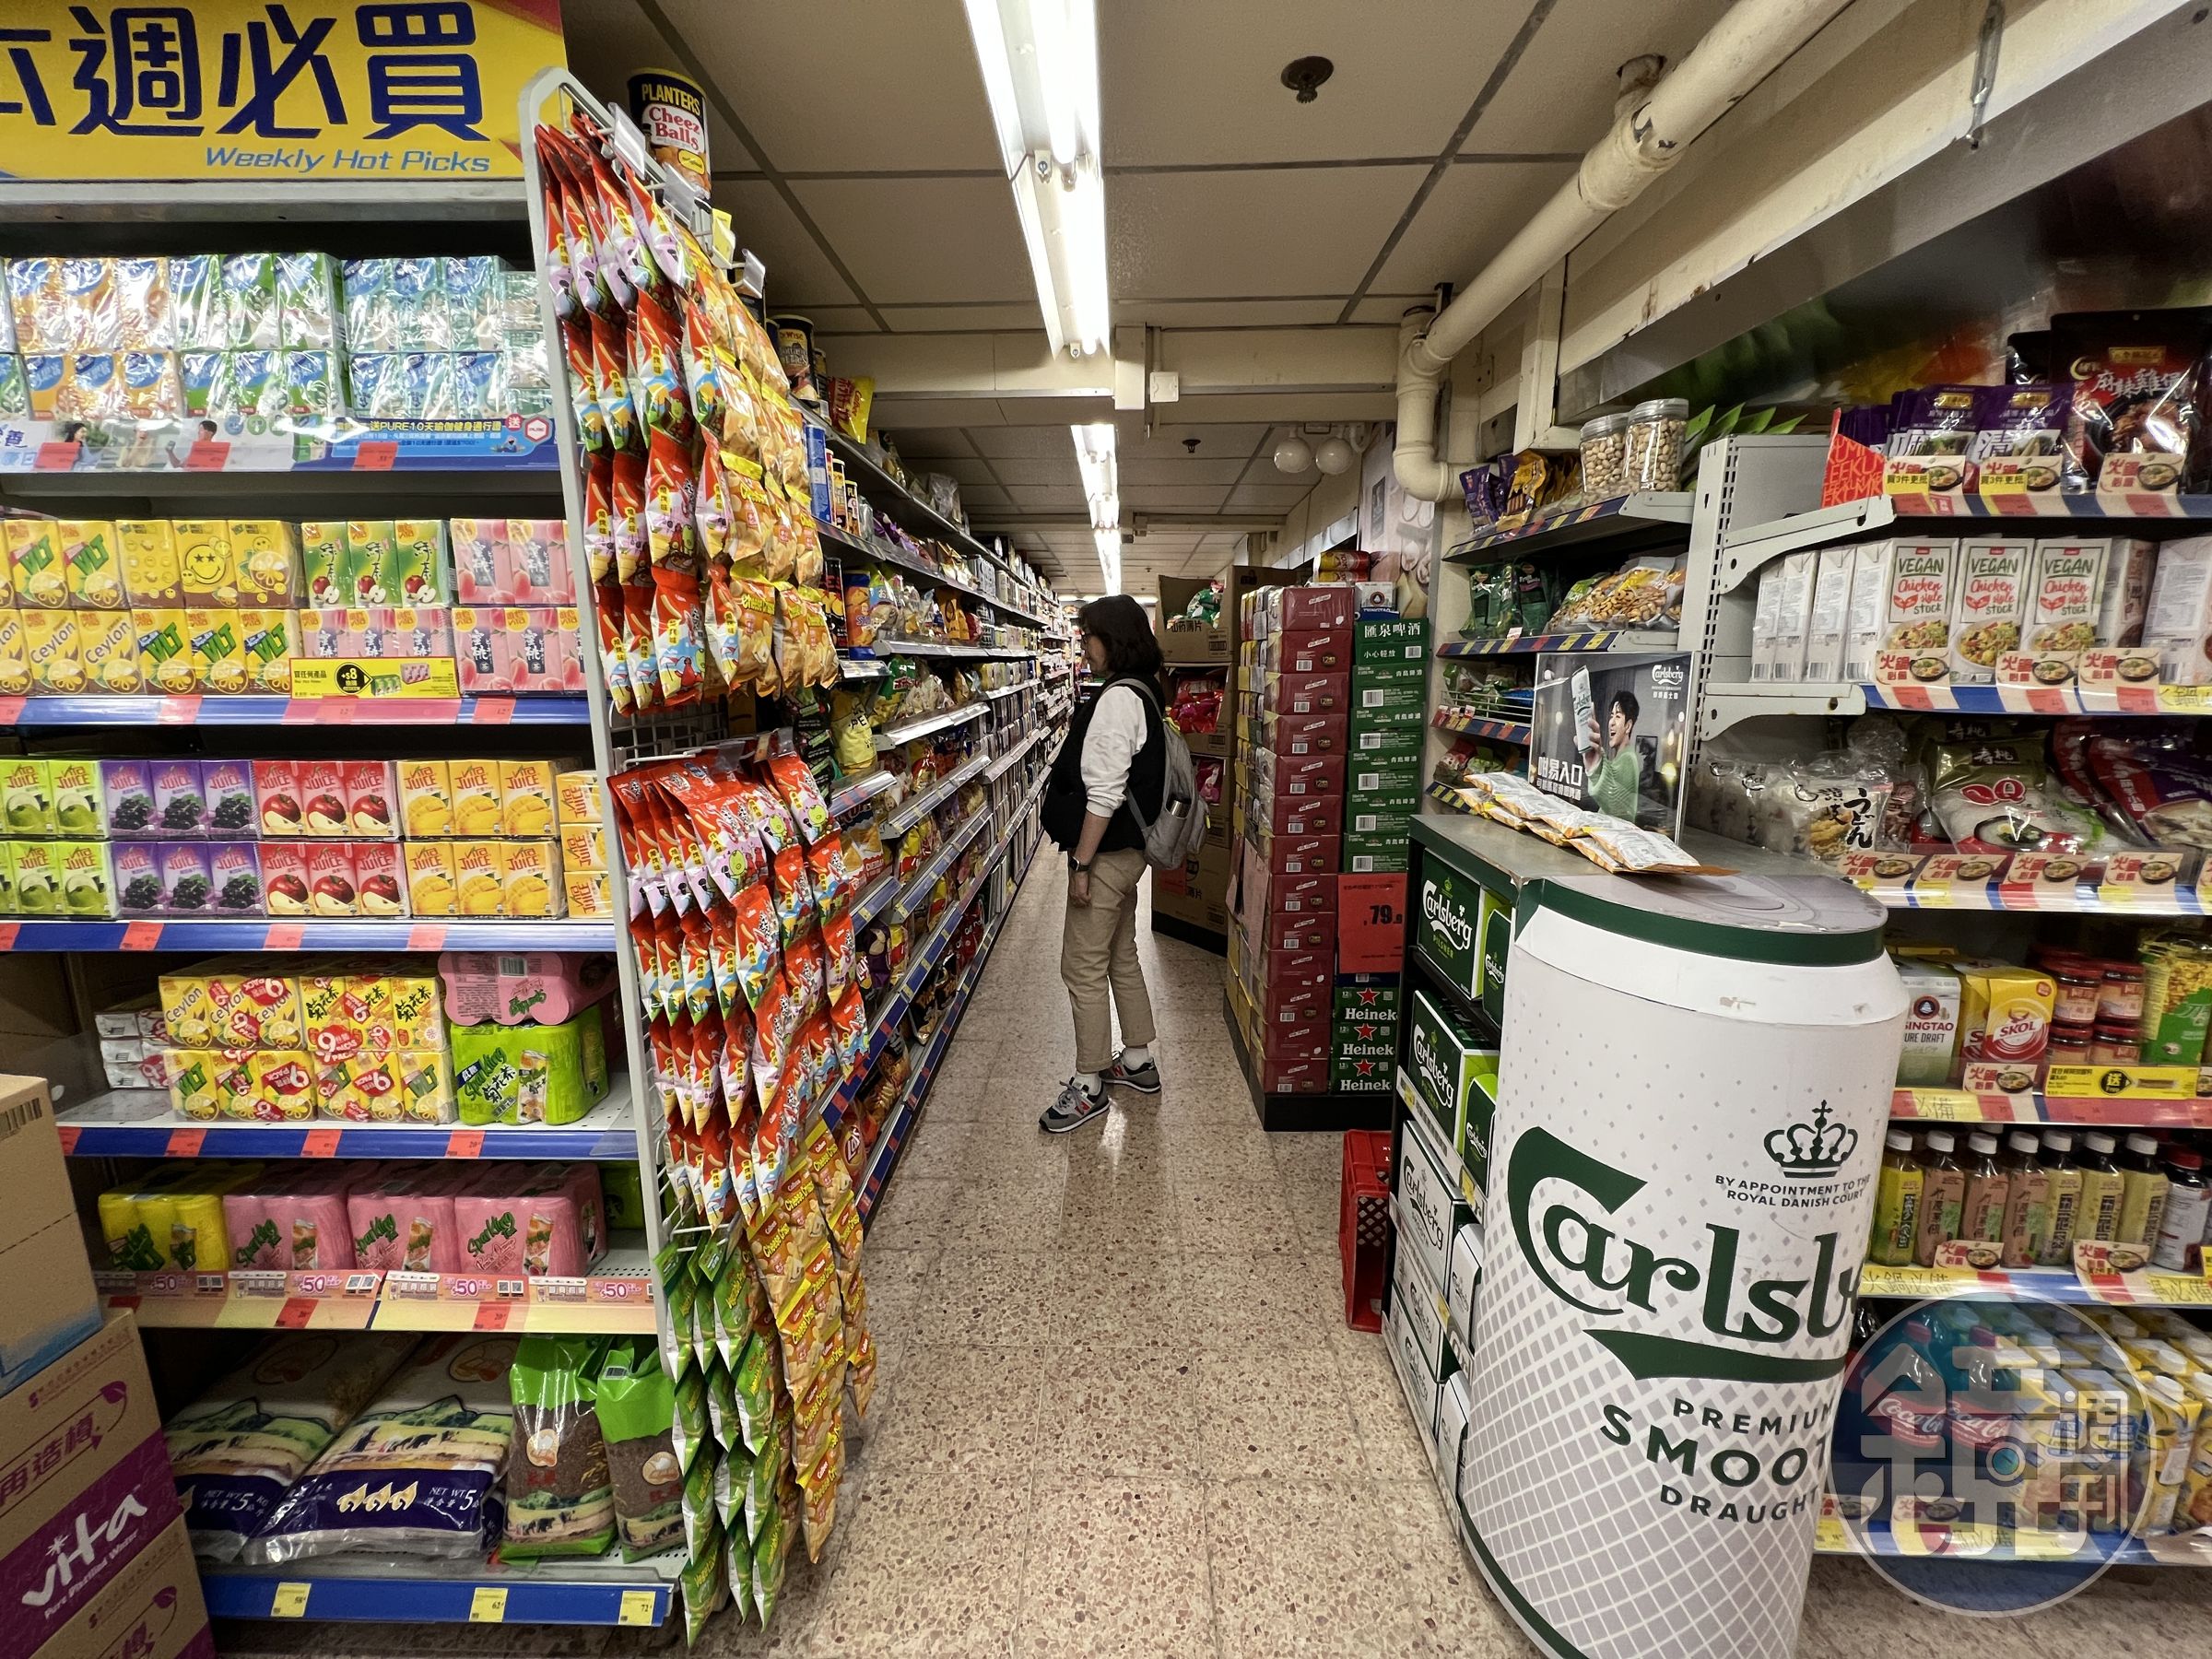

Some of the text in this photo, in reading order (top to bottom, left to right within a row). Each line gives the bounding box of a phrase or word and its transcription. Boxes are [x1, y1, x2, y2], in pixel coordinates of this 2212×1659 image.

[641, 83, 700, 117] PLANTERS
[649, 107, 700, 135] Cheez
[655, 122, 699, 151] Balls
[206, 147, 489, 173] Weekly Hot Picks
[1899, 558, 1944, 573] VEGAN
[1971, 558, 2018, 573] VEGAN
[2045, 559, 2094, 574] VEGAN
[1898, 578, 1943, 593] Chicken
[1971, 579, 2015, 594] Chicken
[2044, 580, 2090, 594] Chicken
[1364, 622, 1420, 638] 匯泉啤酒
[30, 621, 76, 665] Ceylon
[85, 621, 131, 665] Ceylon
[146, 621, 183, 663] VLT
[200, 621, 237, 663] VLT
[253, 621, 288, 663] VLT
[1652, 665, 1684, 685] Carlsberg
[5, 774, 38, 787] JUICE
[55, 774, 88, 788] JUICE
[404, 774, 436, 789] JUICE
[455, 774, 488, 789] JUICE
[506, 774, 538, 789] JUICE
[1843, 787, 1875, 849] うどん
[19, 856, 50, 868] JUICE
[65, 856, 95, 869] JUICE
[410, 855, 441, 869] JUICE
[460, 855, 491, 869] JUICE
[506, 855, 539, 869] JUICE
[1423, 879, 1473, 950] Carlsberg
[1486, 954, 1504, 983] Carlsberg
[166, 987, 203, 1023] Ceylon
[1345, 1007, 1397, 1020] Heinek
[1904, 1033, 1945, 1043] URE DRAFT
[1999, 1021, 2036, 1037] SKOL
[1343, 1043, 1394, 1055] Heinek
[464, 1047, 507, 1101] Sparkling
[1413, 1024, 1454, 1108] Carlsberg
[482, 1063, 518, 1103] 菊花茶
[1340, 1079, 1392, 1091] Heinek
[1465, 1123, 1488, 1159] Carlsberg
[1715, 1173, 1871, 1195] BY APPOINTMENT TO THE
[1404, 1156, 1444, 1251] Carlsberg
[1726, 1189, 1864, 1207] ROYAL DANISH COURT
[467, 1211, 518, 1257] Sparkling
[1508, 1126, 1857, 1344] Carlsb
[452, 1279, 477, 1297] $50
[601, 1282, 628, 1300] $50
[1674, 1397, 1834, 1437] PREMIUM
[1600, 1404, 1828, 1488] SMOOT
[238, 1492, 250, 1512] 5
[429, 1487, 448, 1496] NET
[451, 1488, 465, 1500] WT
[464, 1489, 477, 1511] 5
[44, 1595, 67, 1619] Pure
[109, 1529, 139, 1559] Water
